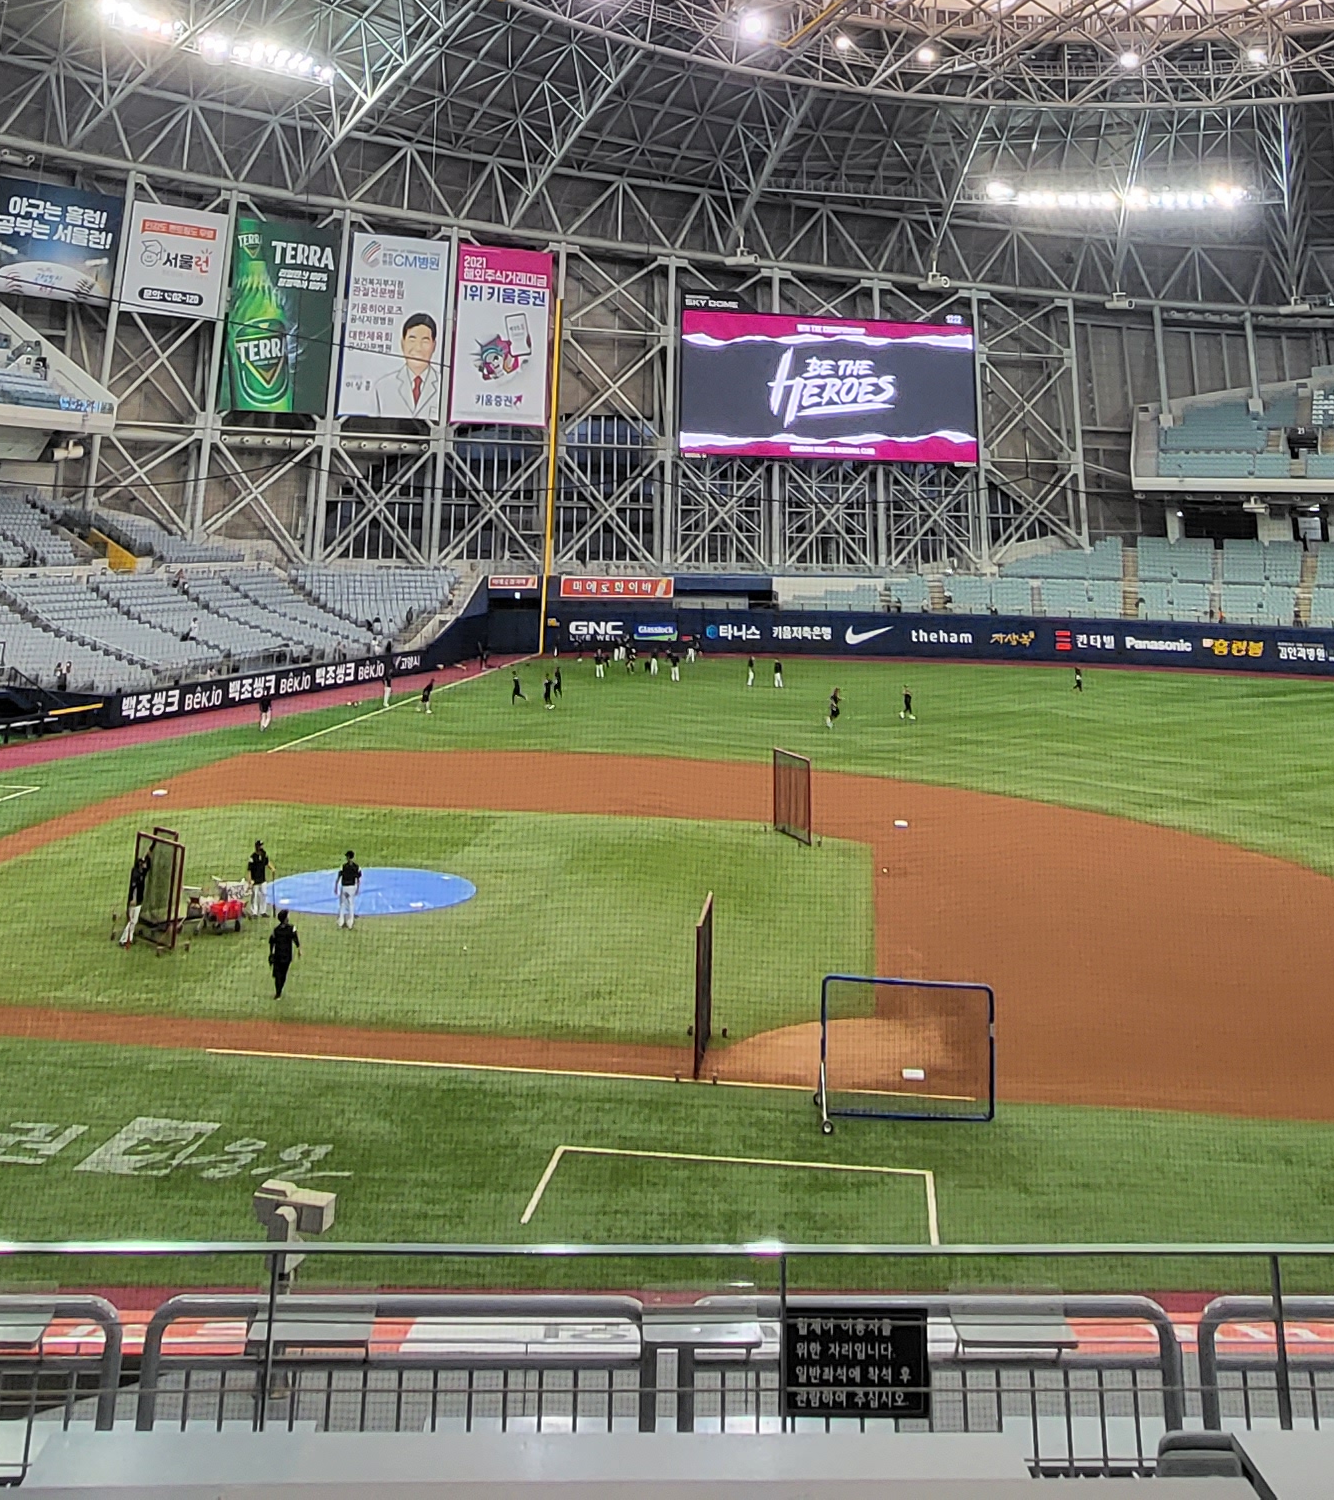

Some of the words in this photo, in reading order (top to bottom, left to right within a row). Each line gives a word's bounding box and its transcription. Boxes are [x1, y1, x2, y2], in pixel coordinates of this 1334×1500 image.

[9, 196, 61, 221] 야구는
[65, 205, 107, 229] 홈런!
[53, 224, 112, 250] 서울런!
[162, 255, 209, 273] 서울런
[271, 241, 334, 270] TERRA
[393, 254, 440, 271] CM병원
[464, 256, 487, 268] 2021
[463, 268, 547, 288] 해외주식거래대금
[353, 286, 405, 299] 관절전문병원
[463, 285, 483, 301] 1위
[487, 286, 546, 307] 키움증권
[351, 303, 404, 316] 키움히어로즈
[685, 298, 707, 307] SKY
[708, 300, 739, 309] DOME
[349, 330, 392, 342] 대한체육회
[803, 357, 835, 376] BE
[837, 359, 874, 376] THE
[766, 346, 896, 428] HEROES
[475, 394, 513, 407] 키움증권
[569, 621, 624, 635] GNC
[638, 625, 674, 634] Glasslock
[718, 624, 761, 641] 타니스
[772, 625, 832, 640] 키움저축은행
[911, 629, 973, 644] theham
[1075, 634, 1115, 649] 칸타빌
[1125, 636, 1192, 652] Panasonic
[1277, 646, 1326, 661] 김안과병원
[316, 662, 355, 688] 백조씽크
[228, 675, 275, 702] 백조씽크
[121, 690, 179, 719] 백조씽크
[796, 1341, 821, 1359] 위한
[795, 1365, 861, 1383] 일반좌석에
[899, 1366, 912, 1384] 후
